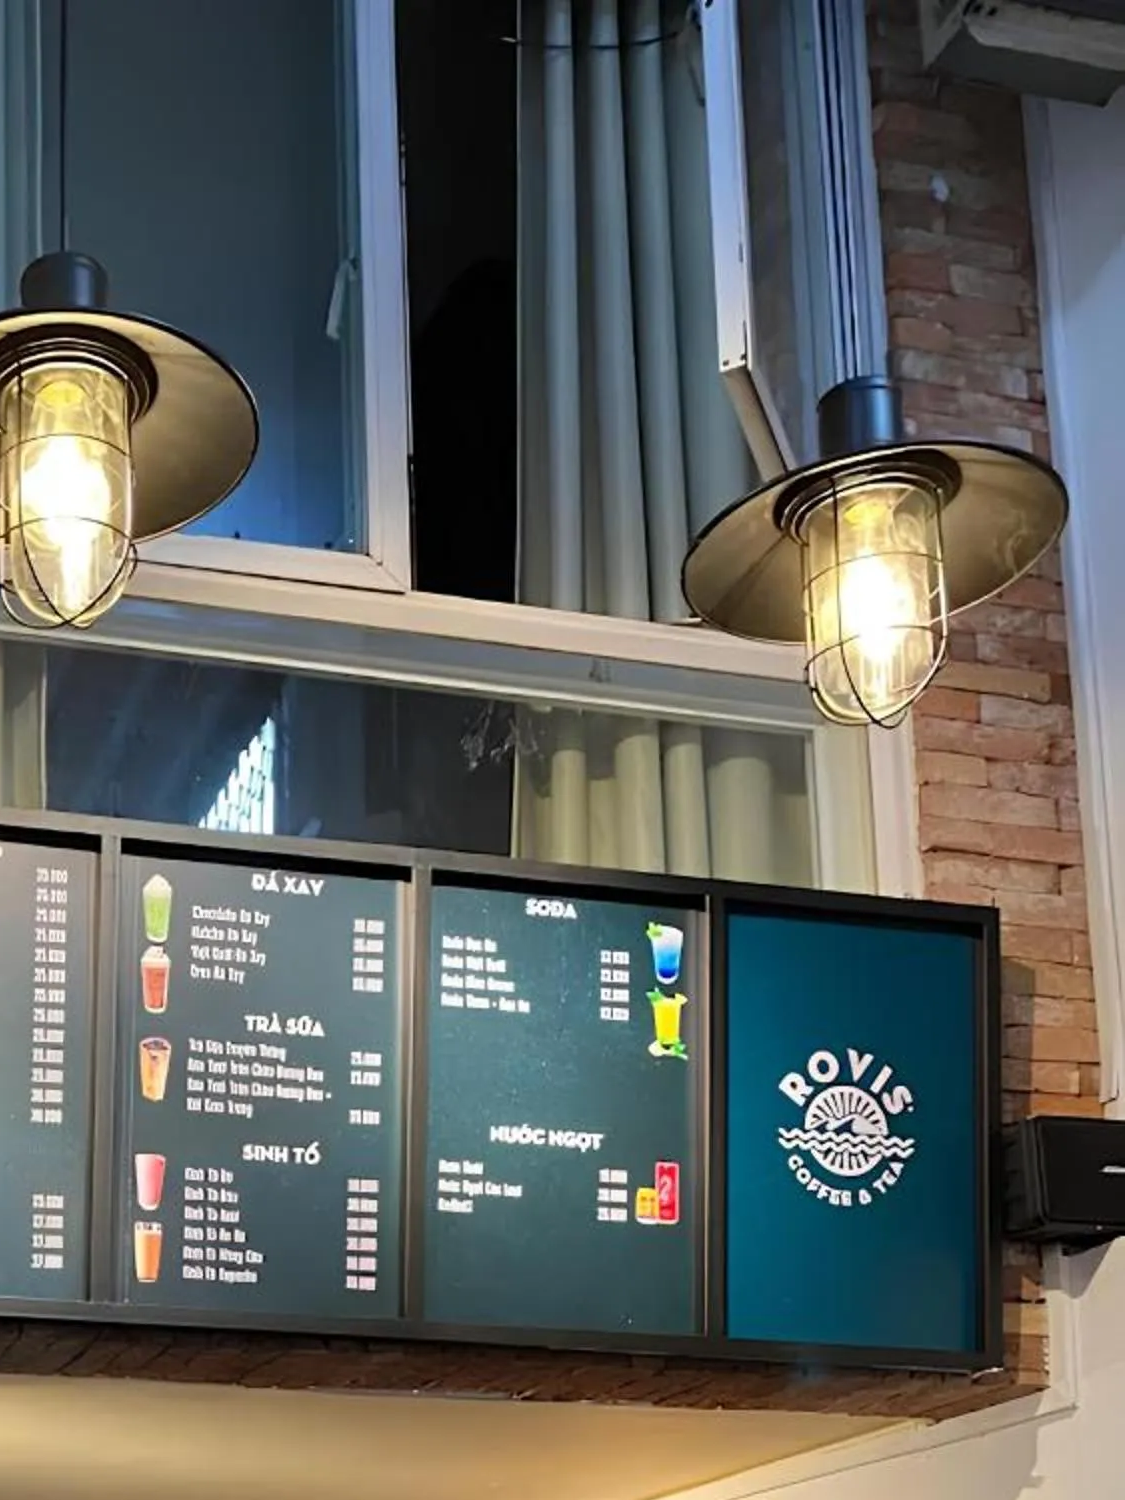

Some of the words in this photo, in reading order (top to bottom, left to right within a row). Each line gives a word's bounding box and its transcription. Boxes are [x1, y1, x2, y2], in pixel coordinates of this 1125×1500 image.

[526, 899, 578, 919] SODA
[244, 1012, 283, 1034] TRÀ
[242, 1144, 289, 1163] SINH
[787, 1154, 853, 1207] COFFEE
